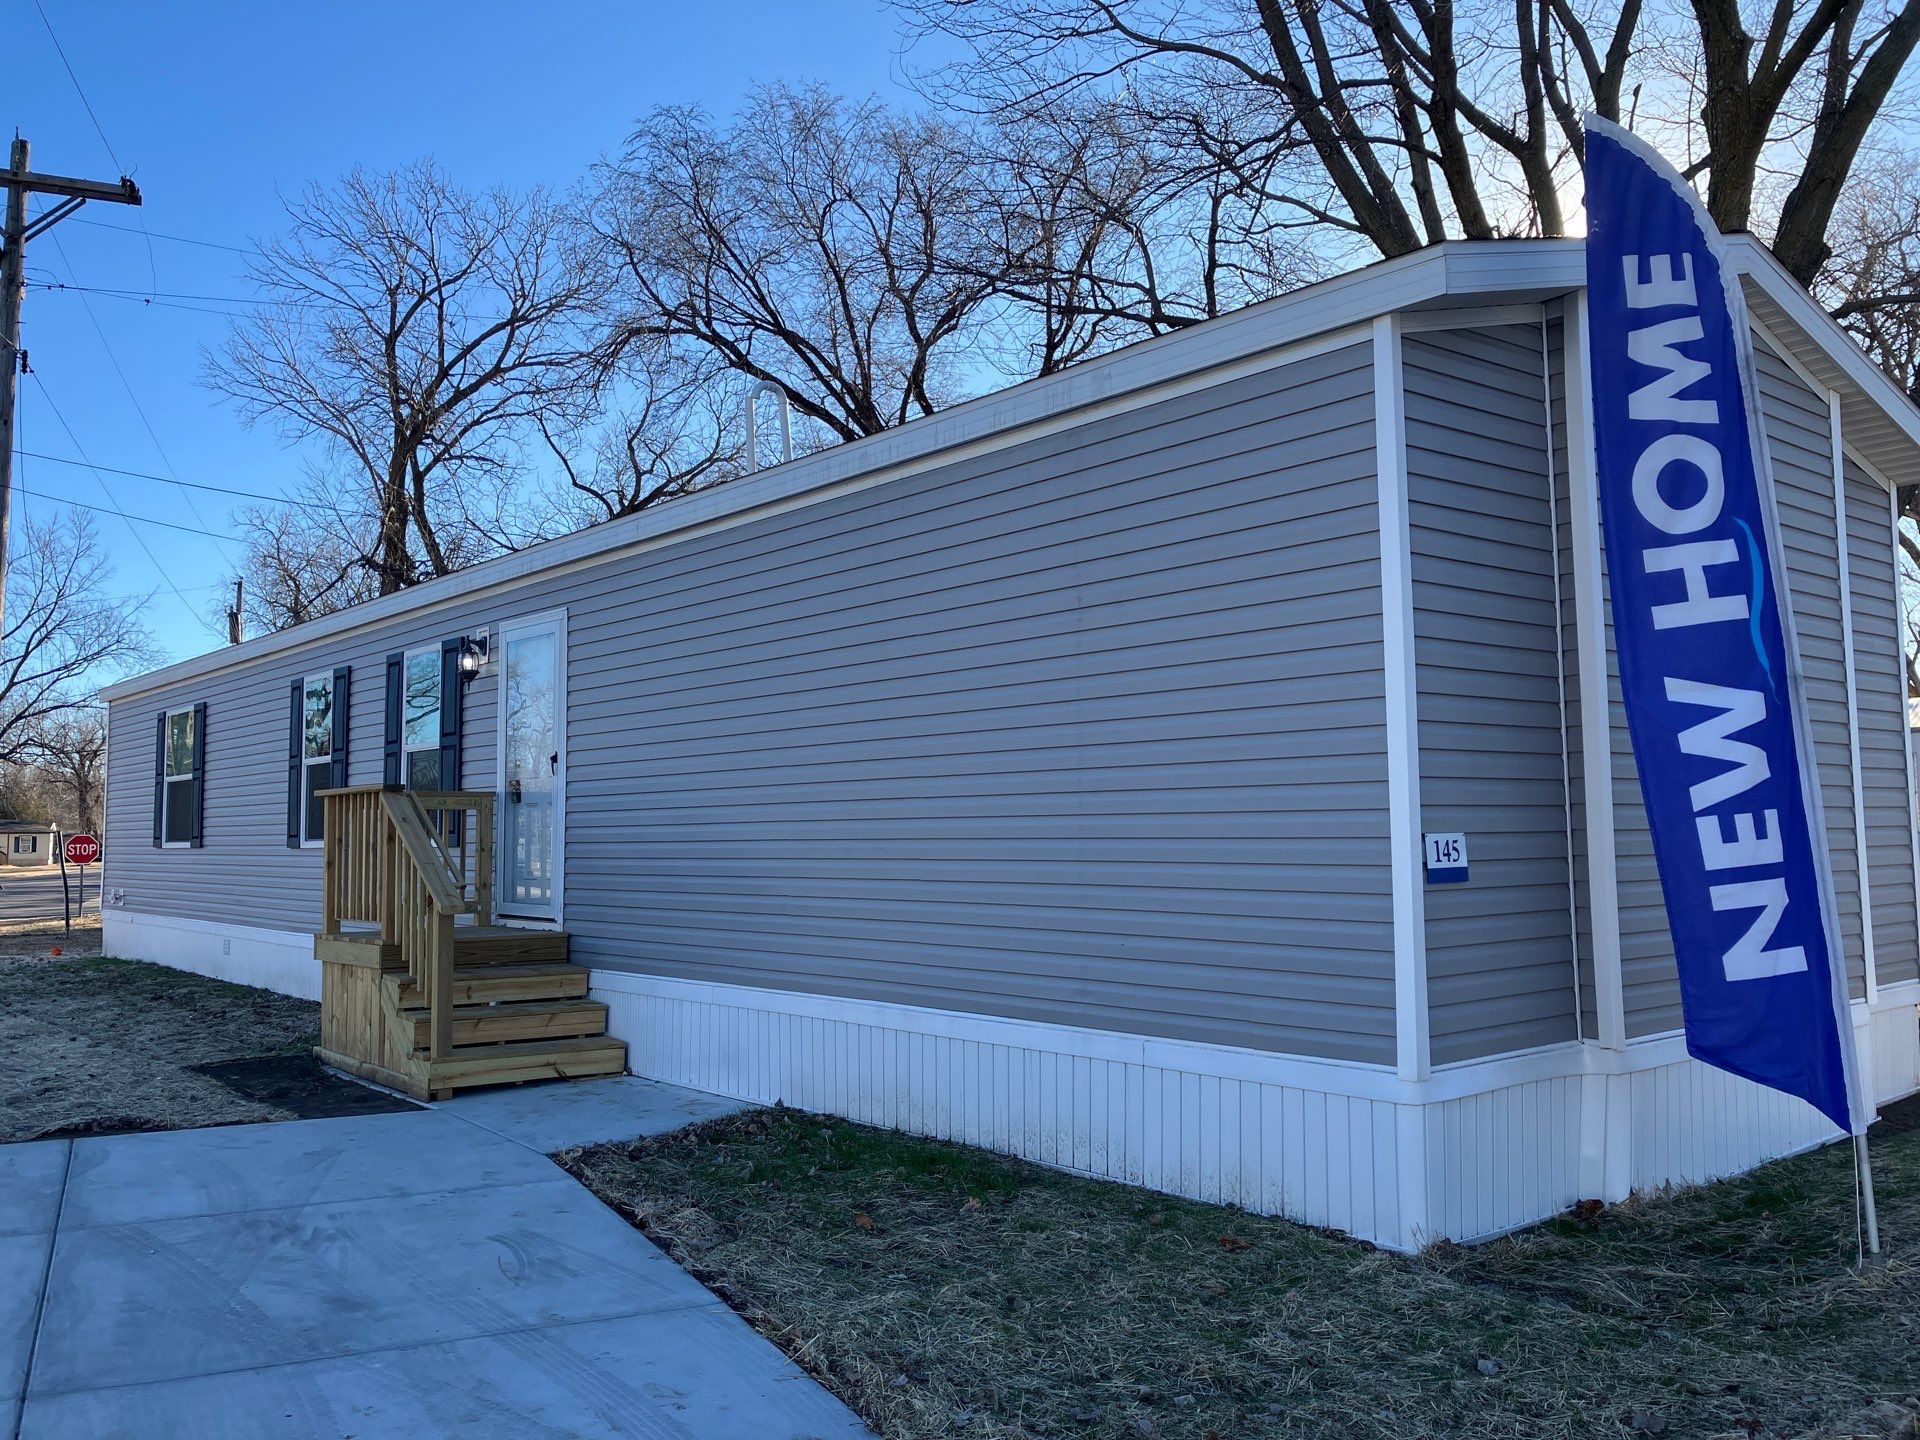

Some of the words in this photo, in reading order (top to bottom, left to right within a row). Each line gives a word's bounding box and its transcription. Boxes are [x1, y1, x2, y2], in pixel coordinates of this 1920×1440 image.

[1621, 251, 1750, 631] HOME
[67, 844, 97, 855] STOP
[1433, 839, 1460, 863] 145
[1663, 676, 1808, 982] NEW
